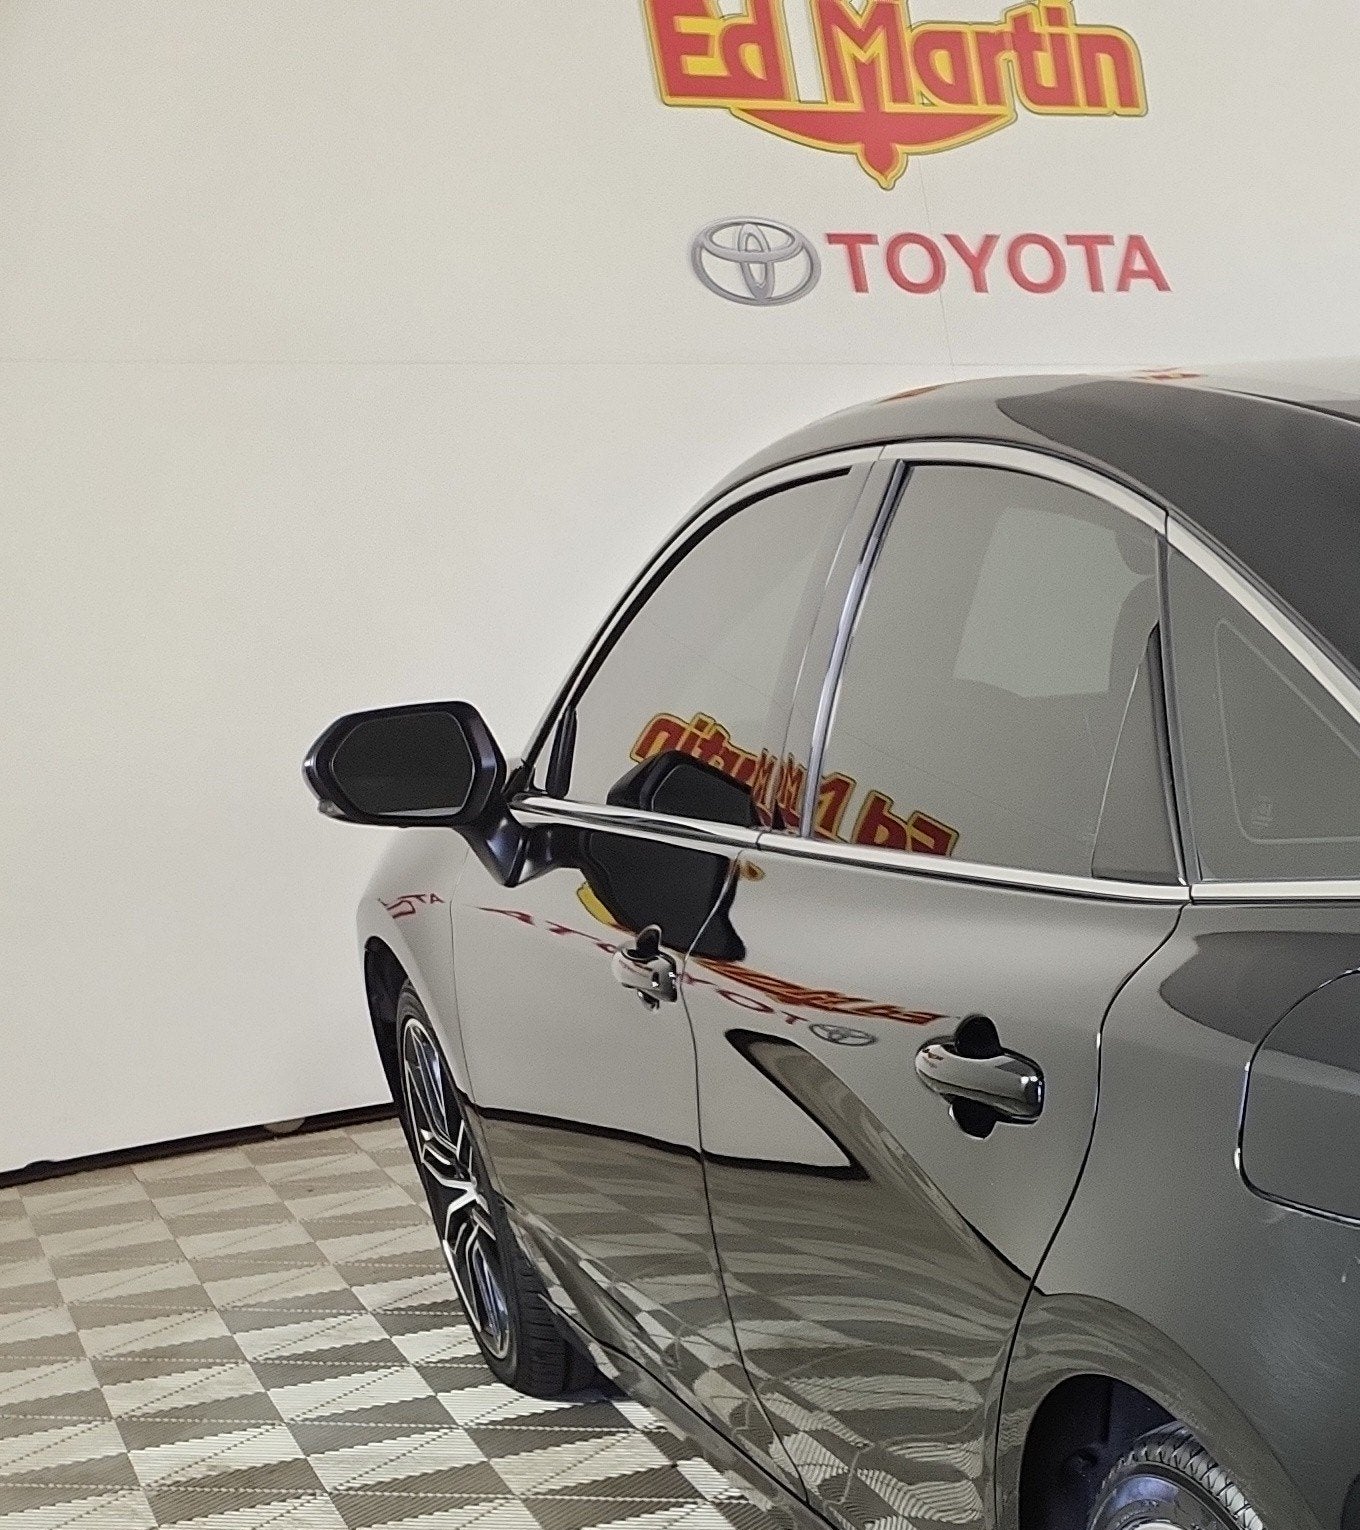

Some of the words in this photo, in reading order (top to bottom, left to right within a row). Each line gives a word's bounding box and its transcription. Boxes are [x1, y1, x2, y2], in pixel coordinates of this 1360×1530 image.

[642, 0, 792, 101] Ed
[815, 0, 1142, 111] Martin
[826, 233, 1172, 293] TOYOTA
